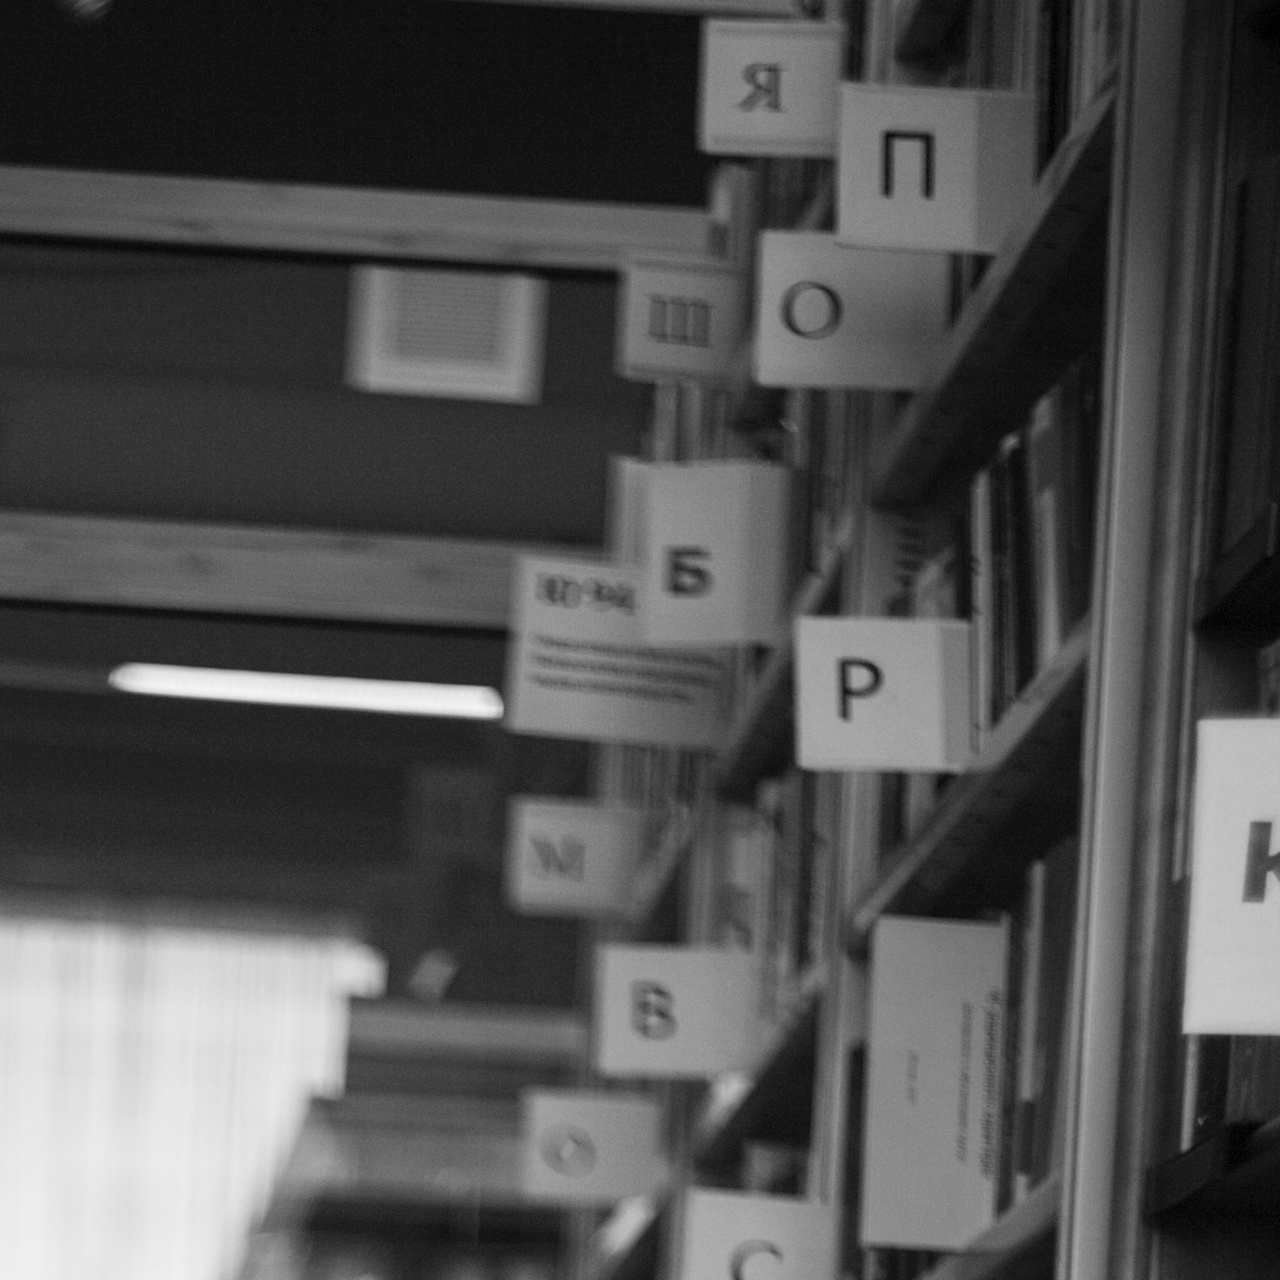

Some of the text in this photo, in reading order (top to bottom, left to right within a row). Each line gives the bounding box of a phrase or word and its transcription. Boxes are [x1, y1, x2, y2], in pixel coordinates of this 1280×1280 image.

[734, 60, 786, 113] Я
[883, 130, 934, 199] П
[646, 292, 715, 349] Ш
[780, 280, 844, 341] О
[665, 547, 717, 599] Б
[836, 657, 886, 722] Р
[629, 978, 678, 1041] В
